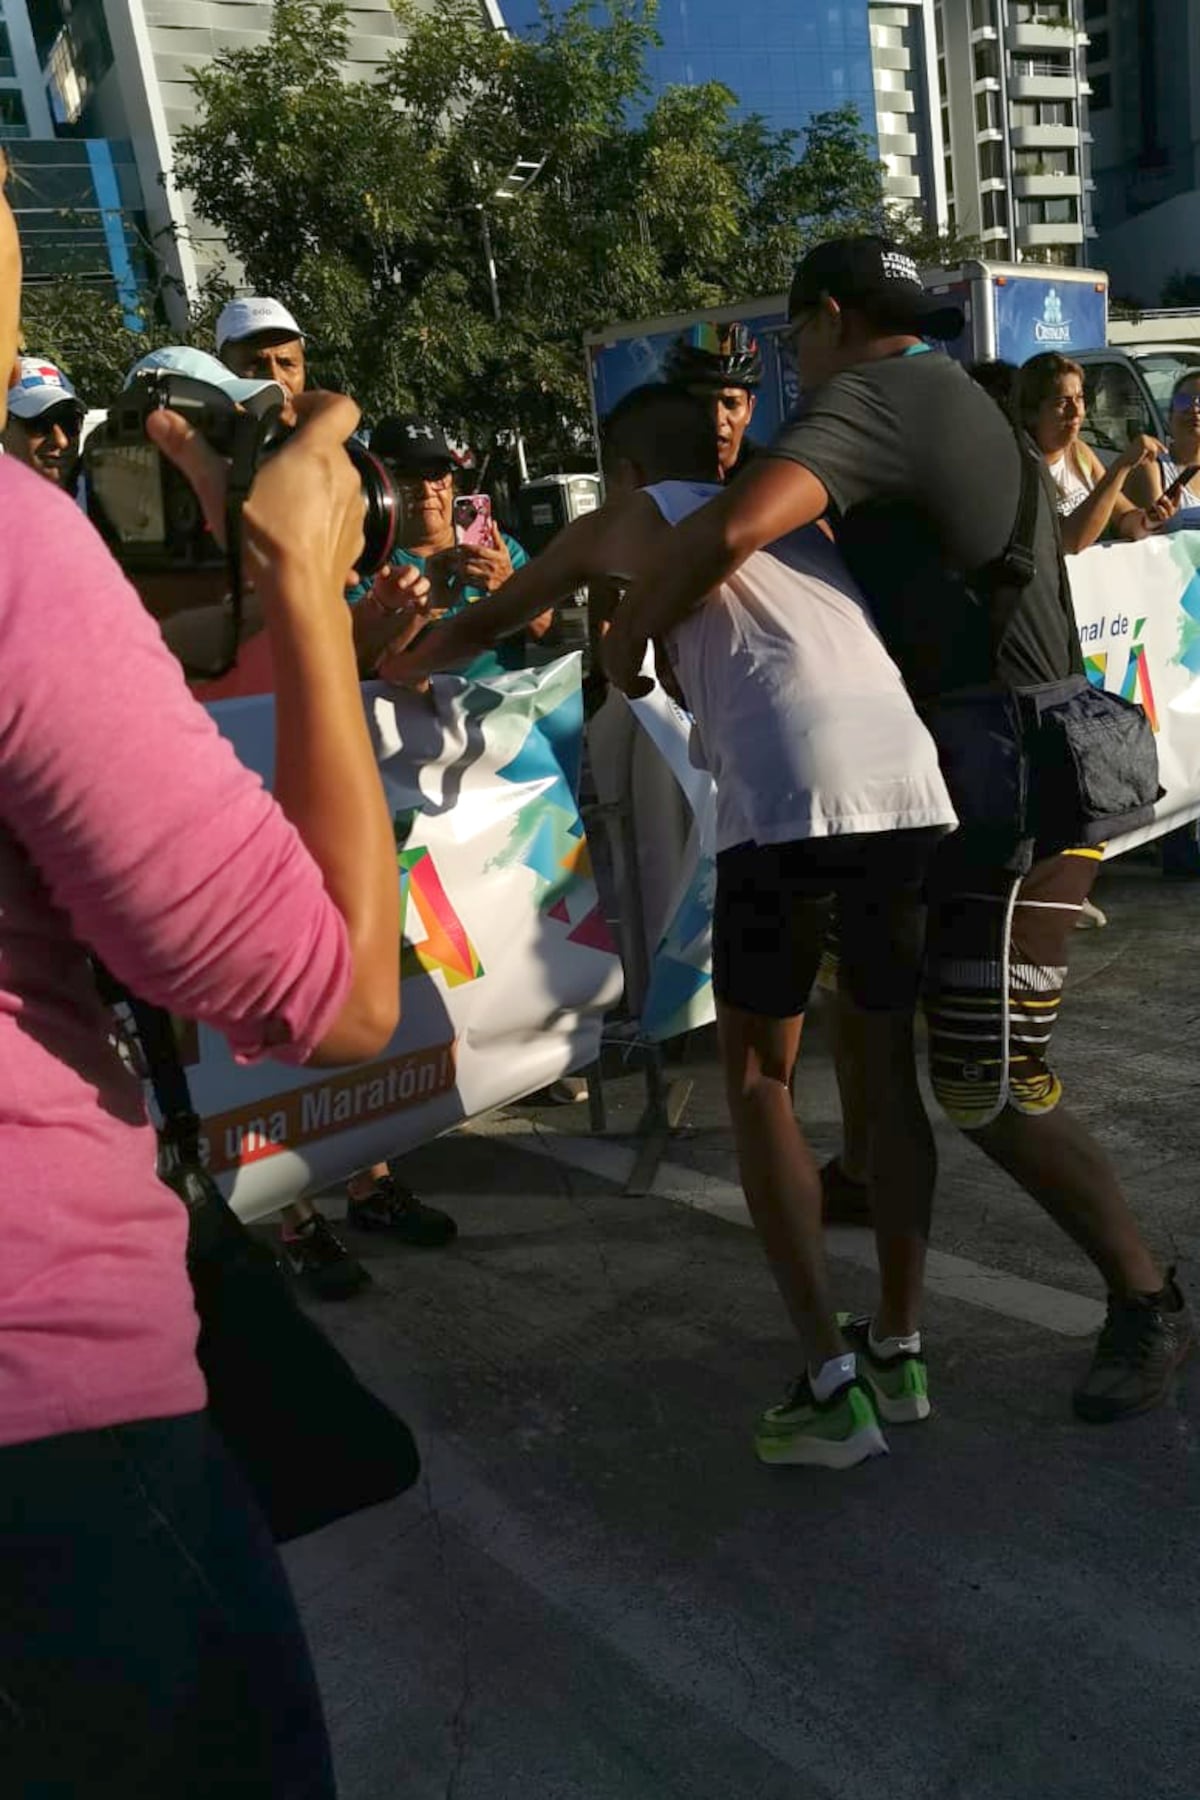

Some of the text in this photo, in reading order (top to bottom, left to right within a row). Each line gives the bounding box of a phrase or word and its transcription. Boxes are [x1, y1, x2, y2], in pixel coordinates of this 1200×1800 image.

[1110, 613, 1129, 637] de
[226, 1108, 288, 1160] una
[302, 1051, 449, 1132] Maratón!
